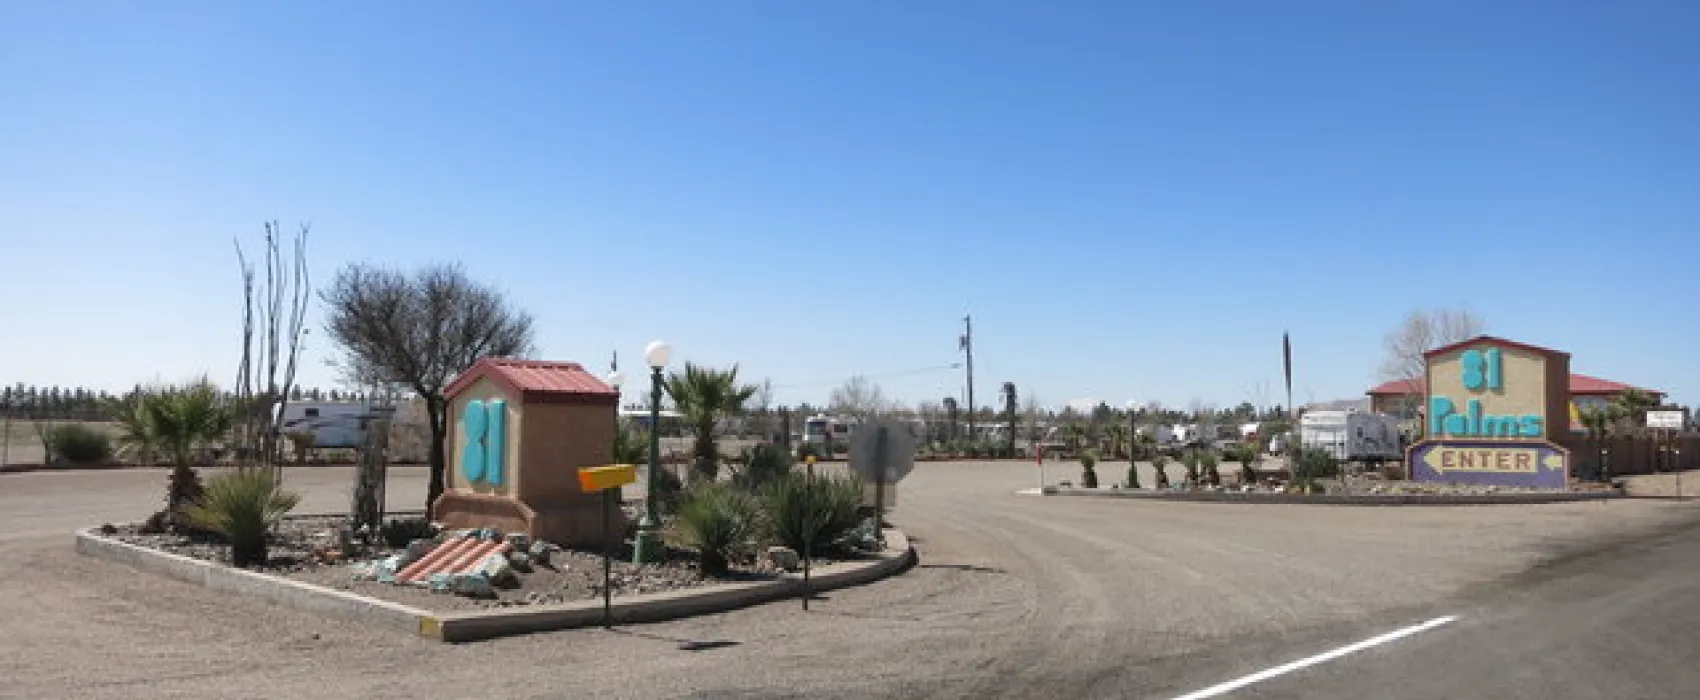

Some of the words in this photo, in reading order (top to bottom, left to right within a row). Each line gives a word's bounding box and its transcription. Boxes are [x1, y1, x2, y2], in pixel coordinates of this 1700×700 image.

[1460, 349, 1502, 391] 81
[1431, 396, 1543, 438] Palms
[461, 398, 507, 484] 81
[1441, 450, 1531, 470] ENTER
